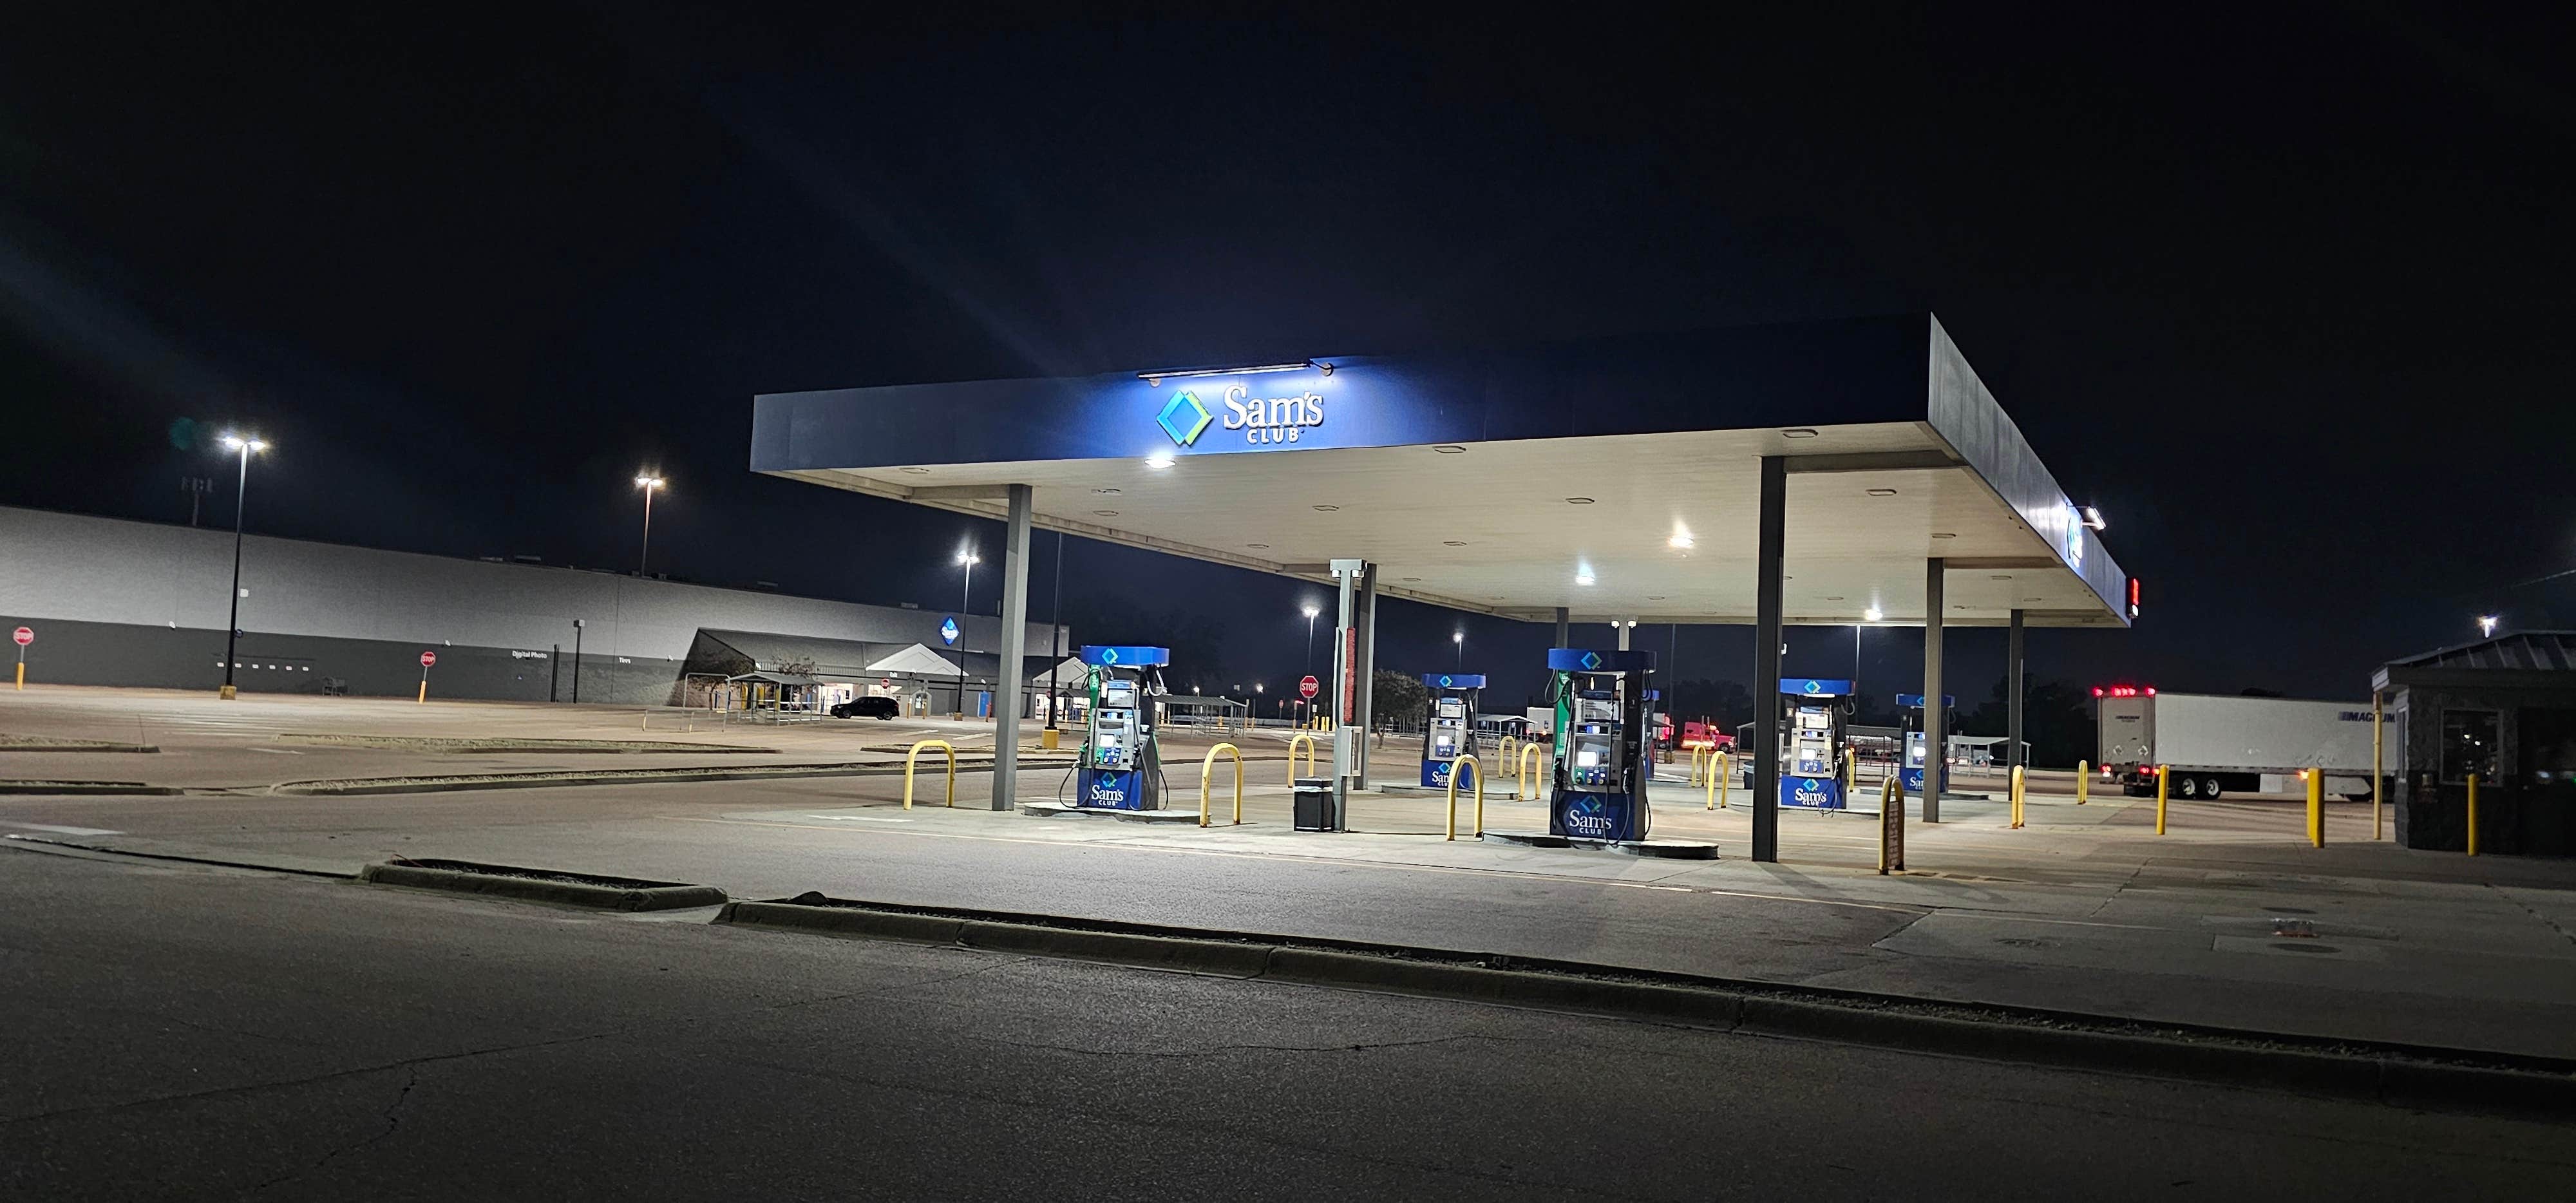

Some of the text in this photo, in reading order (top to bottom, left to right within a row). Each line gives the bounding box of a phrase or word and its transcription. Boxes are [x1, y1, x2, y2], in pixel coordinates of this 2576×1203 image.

[1224, 385, 1323, 430] Sam's
[1247, 427, 1300, 444] CLUB
[512, 650, 530, 659] Digital
[1302, 683, 1317, 691] STOP
[2348, 712, 2395, 723] MAGUM
[1432, 771, 1449, 782] Sam
[1092, 784, 1124, 802] Sam's
[1795, 788, 1827, 803] Sam's
[1569, 810, 1613, 829] Sams
